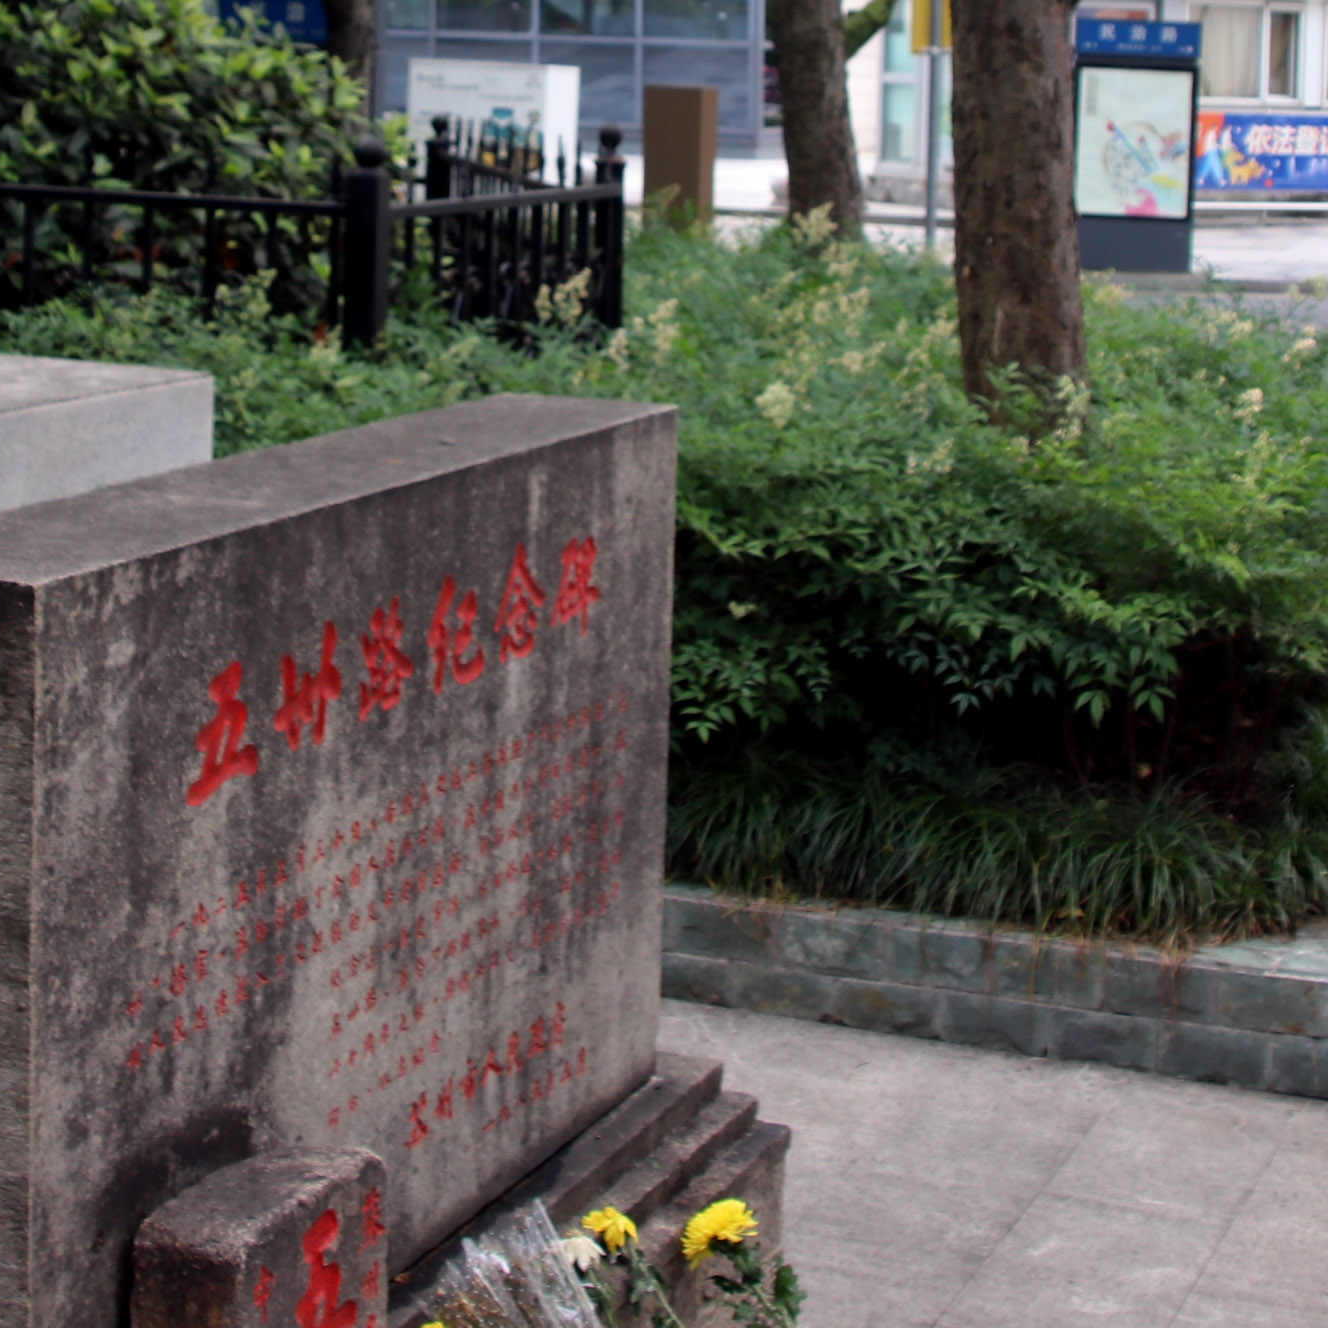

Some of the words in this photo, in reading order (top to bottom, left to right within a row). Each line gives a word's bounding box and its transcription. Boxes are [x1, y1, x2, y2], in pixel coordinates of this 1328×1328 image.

[184, 537, 600, 807] 五卅路纪念碑
